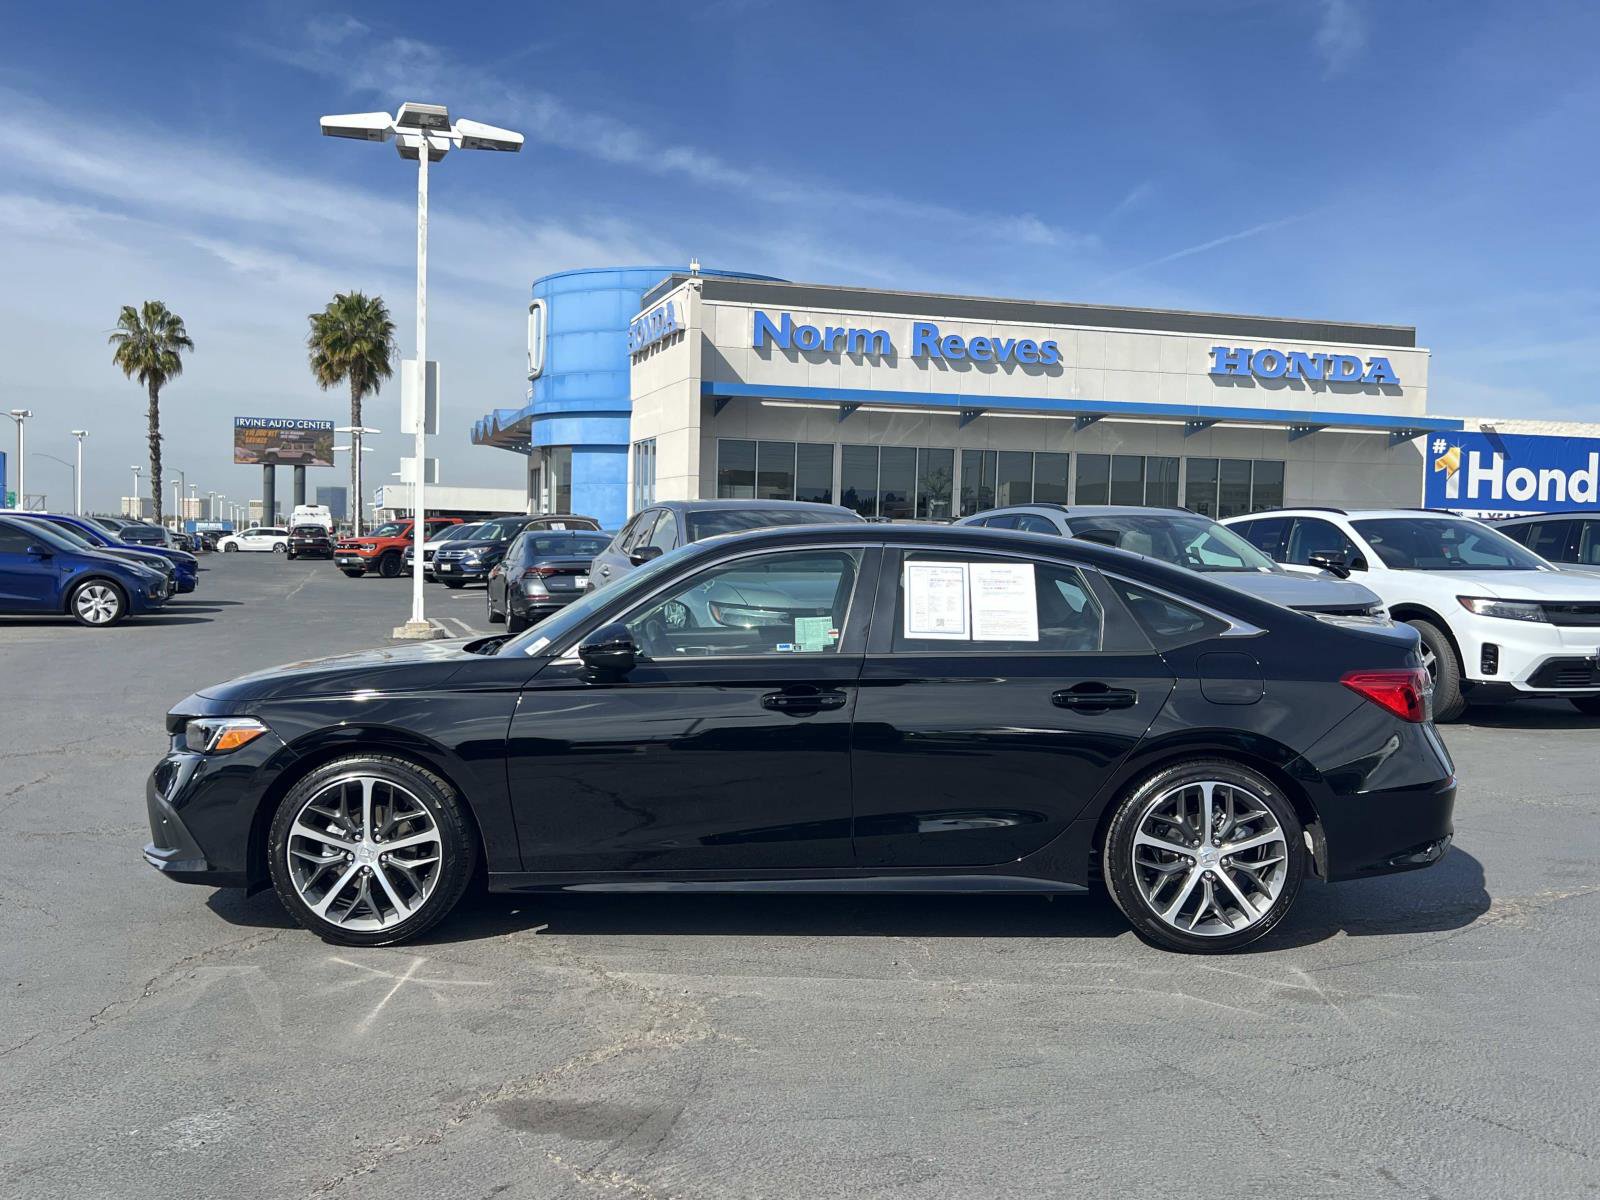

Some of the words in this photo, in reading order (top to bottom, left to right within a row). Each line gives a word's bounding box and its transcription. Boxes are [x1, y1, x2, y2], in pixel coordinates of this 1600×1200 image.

[753, 310, 892, 356] Norm
[912, 321, 1060, 366] Reeves
[1209, 346, 1401, 385] HONDA
[236, 418, 266, 427] IRVINE
[268, 419, 295, 429] AUTO
[297, 420, 332, 430] CENTER
[1467, 450, 1600, 503] Hond
